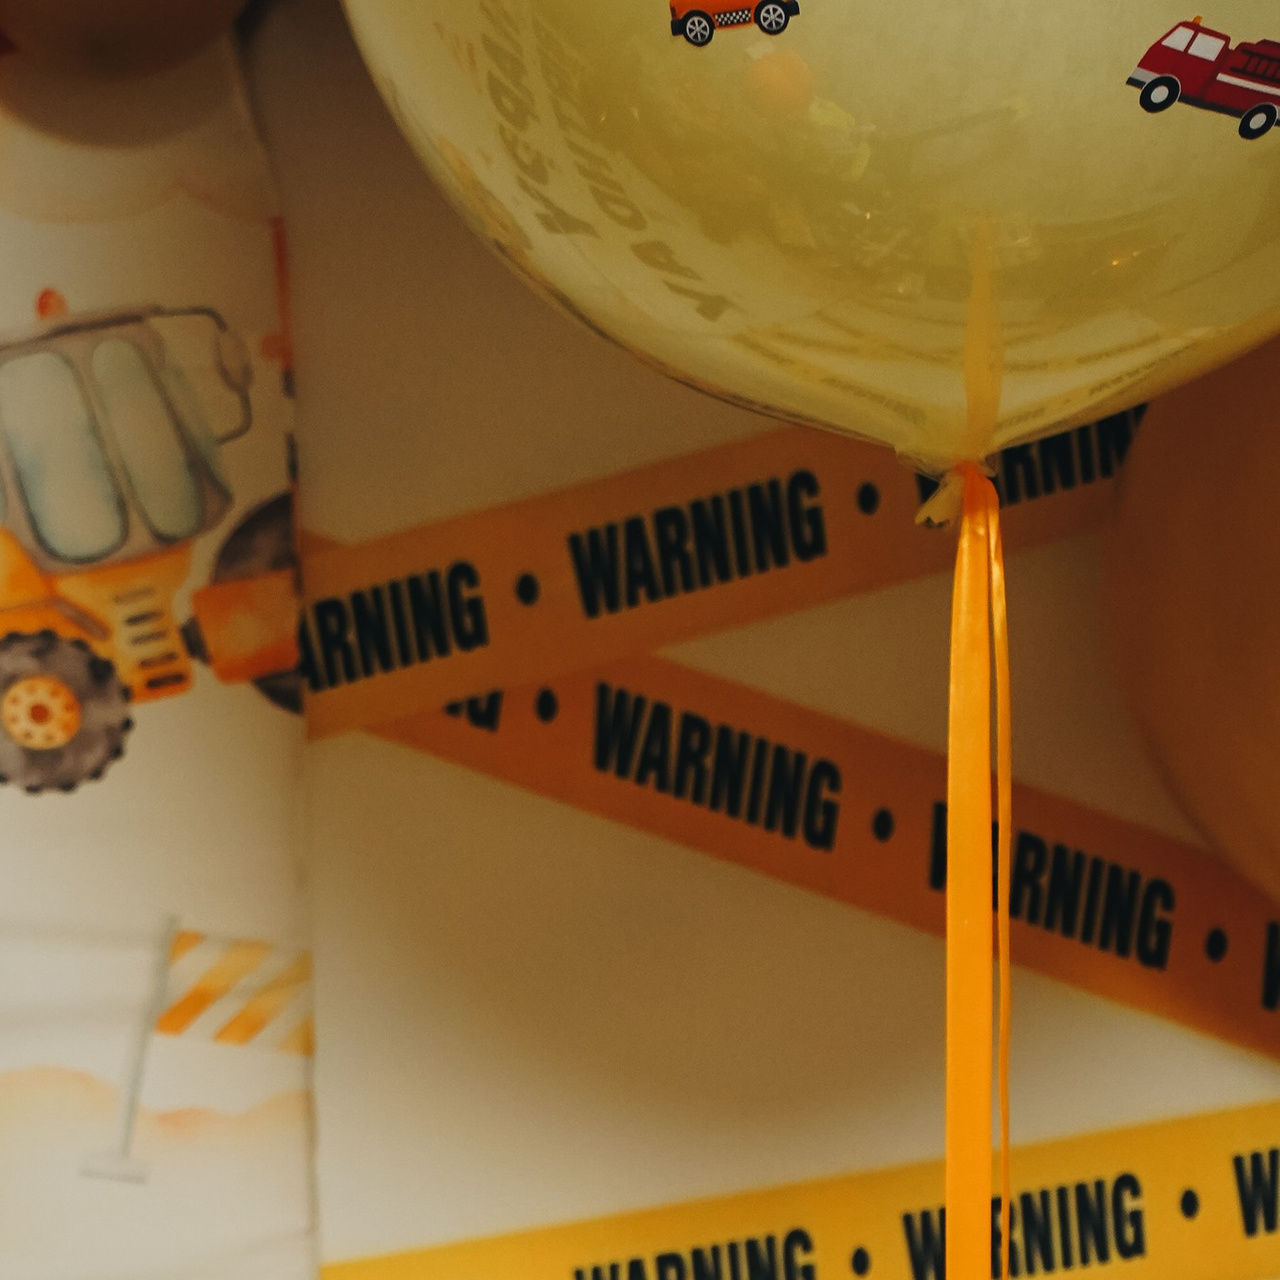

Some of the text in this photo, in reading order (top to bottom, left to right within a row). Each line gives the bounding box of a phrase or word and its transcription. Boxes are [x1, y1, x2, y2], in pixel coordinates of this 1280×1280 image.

[568, 468, 827, 620] WARNING
[593, 681, 842, 852] WARNING
[928, 801, 1175, 970] RNING
